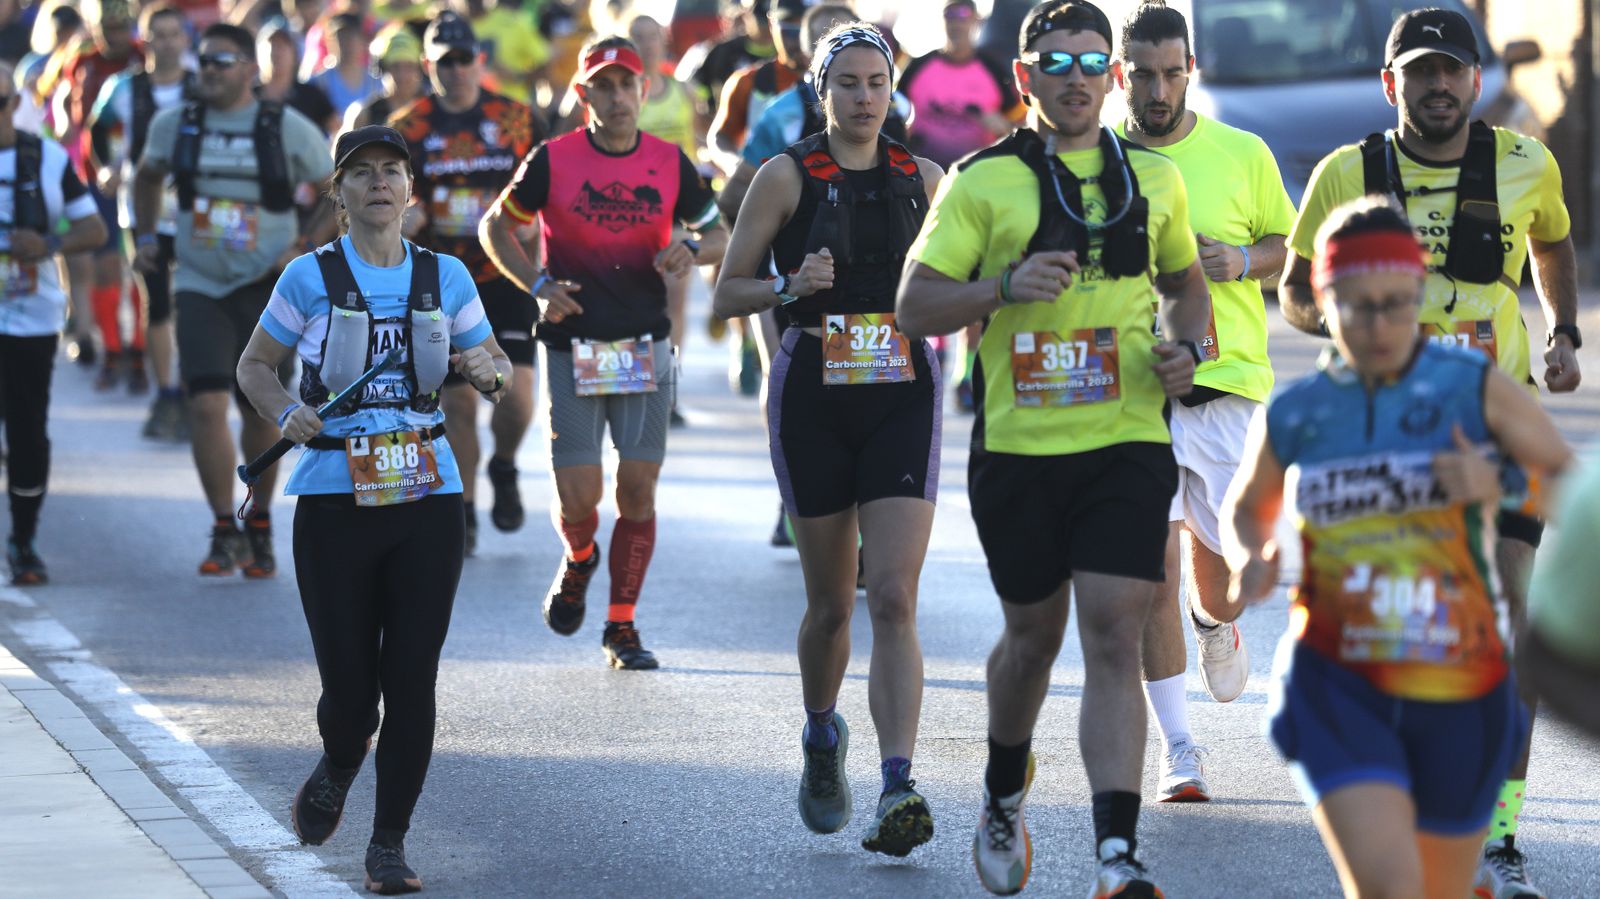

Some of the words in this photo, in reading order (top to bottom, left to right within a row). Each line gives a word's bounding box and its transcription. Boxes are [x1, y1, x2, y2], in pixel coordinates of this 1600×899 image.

[849, 324, 892, 351] 322
[826, 359, 887, 369] Carbonerilla
[888, 358, 908, 368] 2023
[1041, 341, 1088, 371] 357
[1016, 380, 1084, 392] Carbonerilla
[1088, 375, 1115, 387] 2023
[374, 443, 419, 471] 388
[355, 478, 415, 492] Carbonerilla
[416, 474, 436, 485] 2023
[1371, 576, 1436, 617] 304
